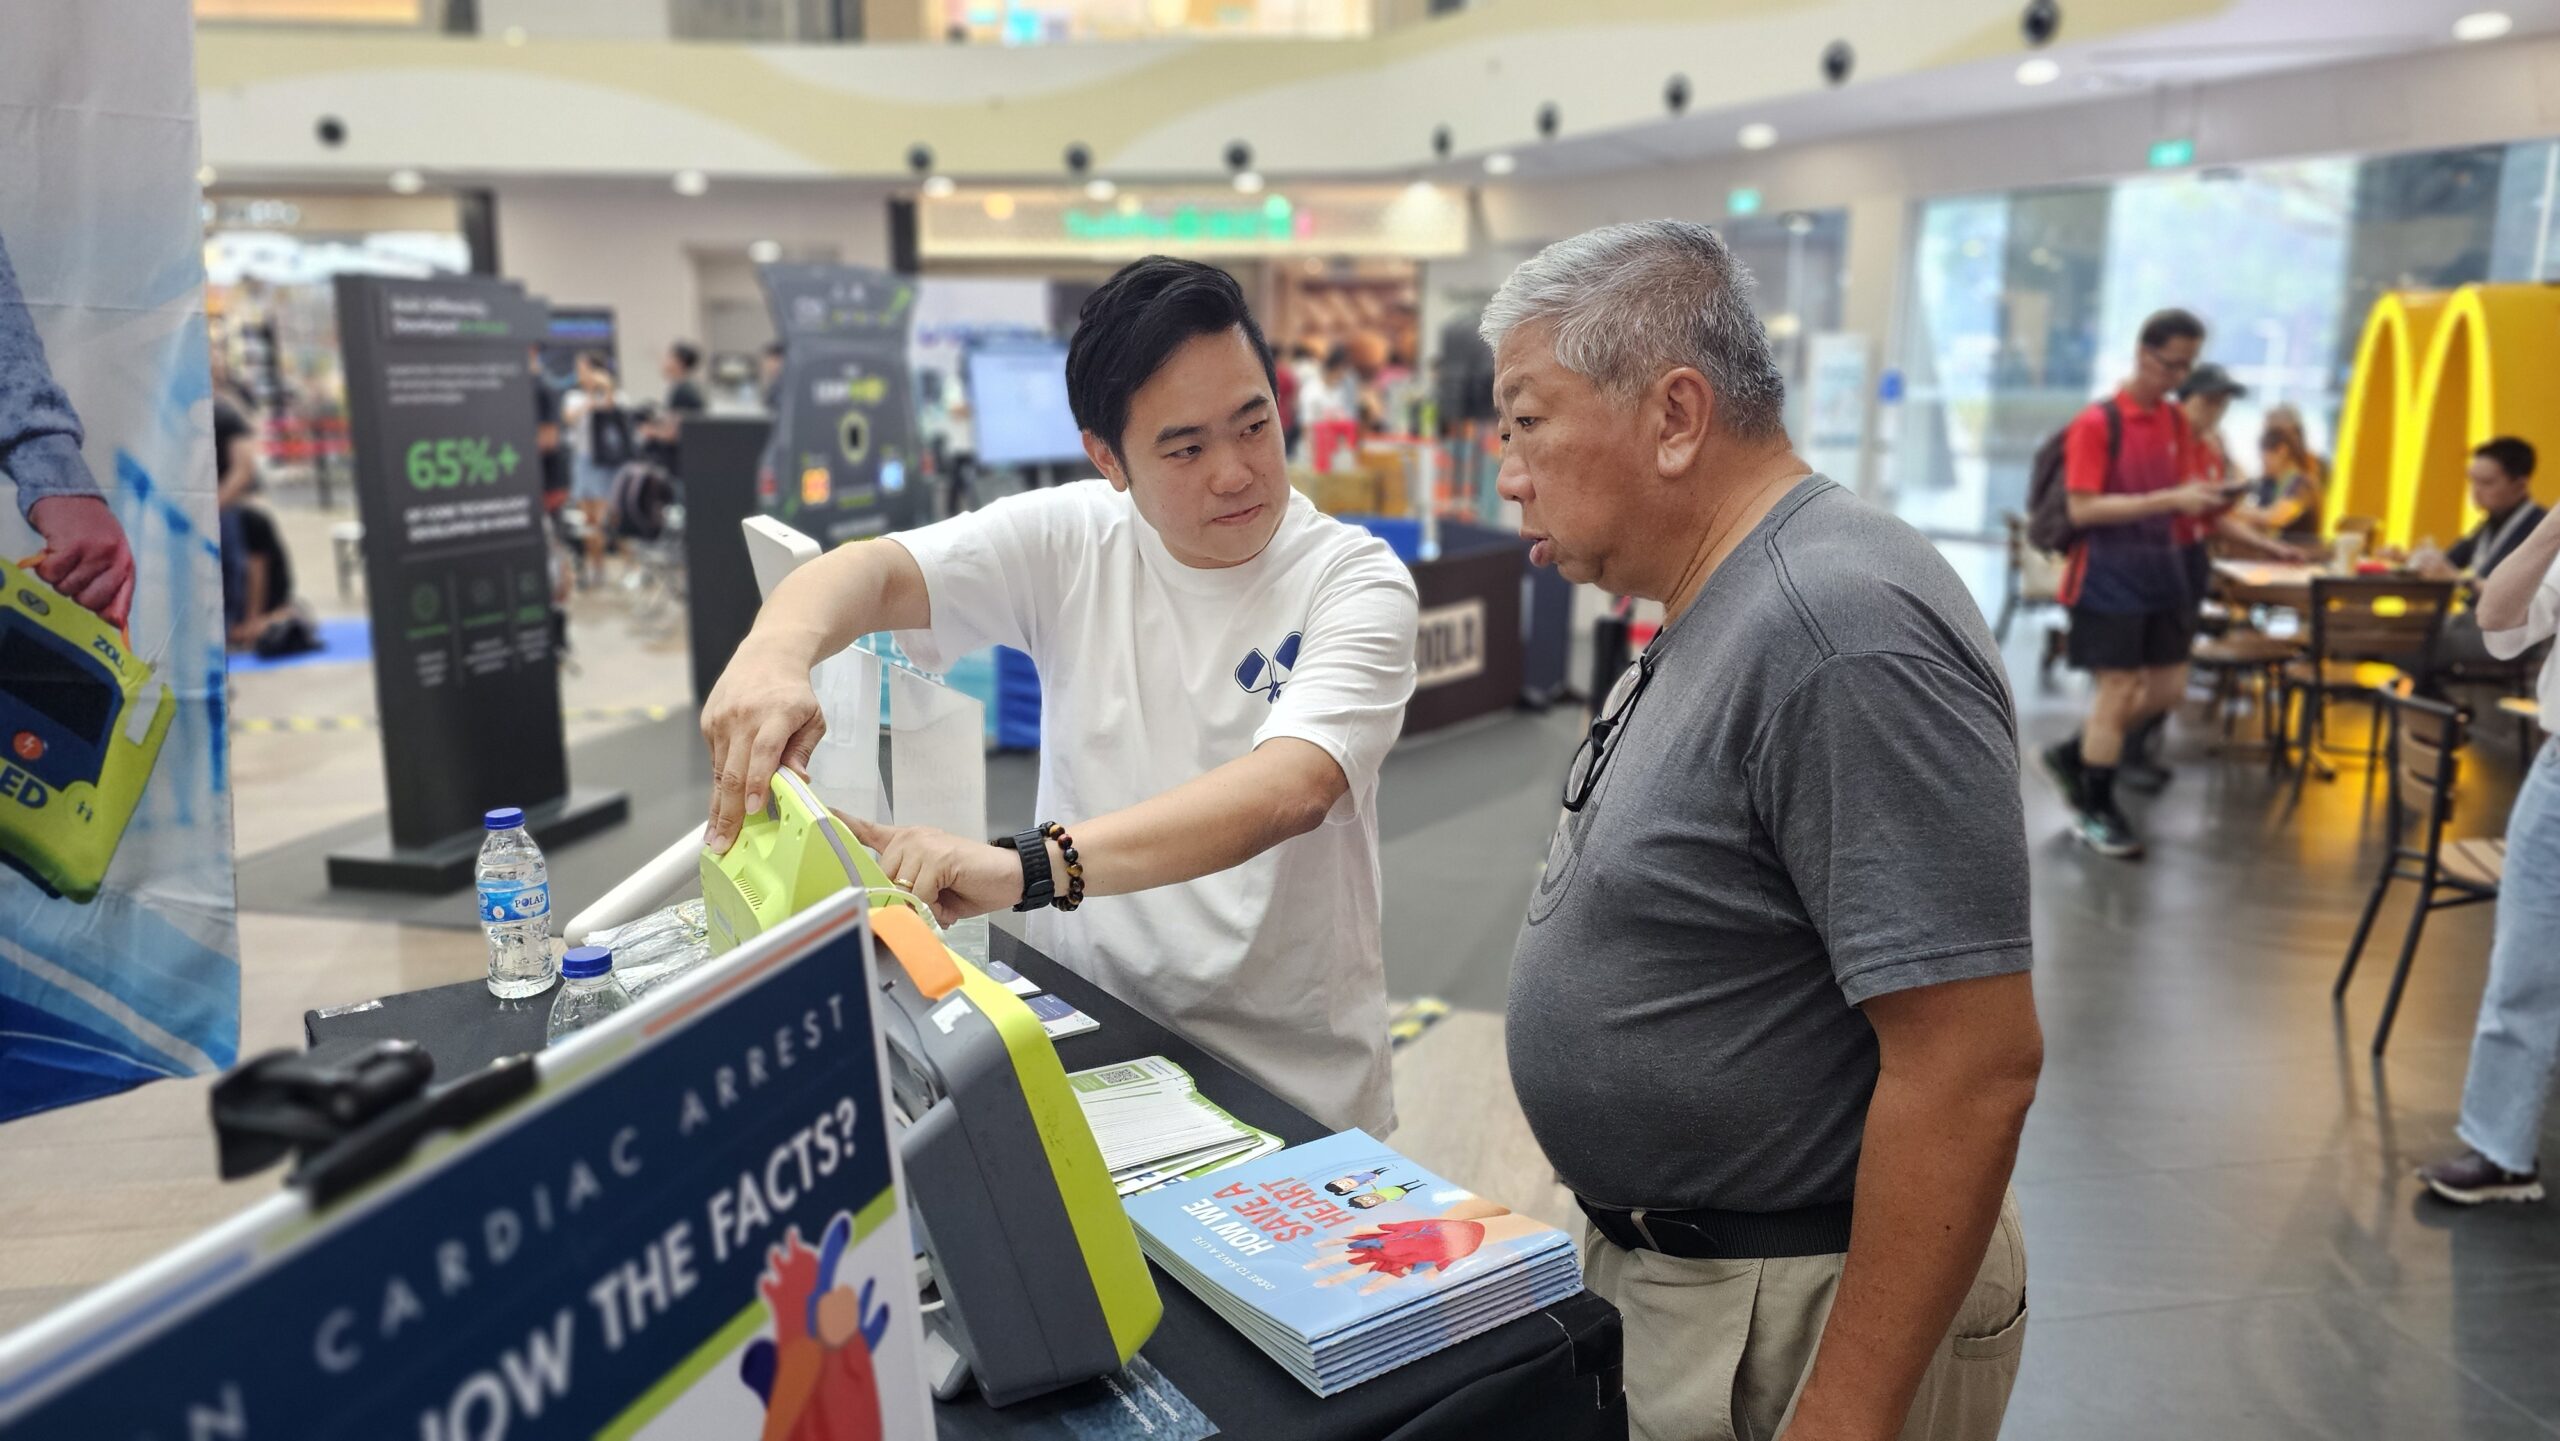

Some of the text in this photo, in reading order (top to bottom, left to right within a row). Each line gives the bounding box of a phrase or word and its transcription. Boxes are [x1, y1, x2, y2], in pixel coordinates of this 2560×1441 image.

[406, 434, 520, 490] 65%+
[314, 1125, 642, 1374] CARDIAC
[679, 993, 843, 1136] ARREST
[1212, 1181, 1315, 1242] SAVE A
[1258, 1176, 1356, 1229] HEART
[587, 1220, 699, 1350] THE
[707, 1097, 857, 1260] FACTS?
[1181, 1198, 1276, 1256] HOW WE
[1192, 1235, 1212, 1249] LIFE
[1215, 1252, 1239, 1268] SAVE
[1235, 1266, 1250, 1276] TO
